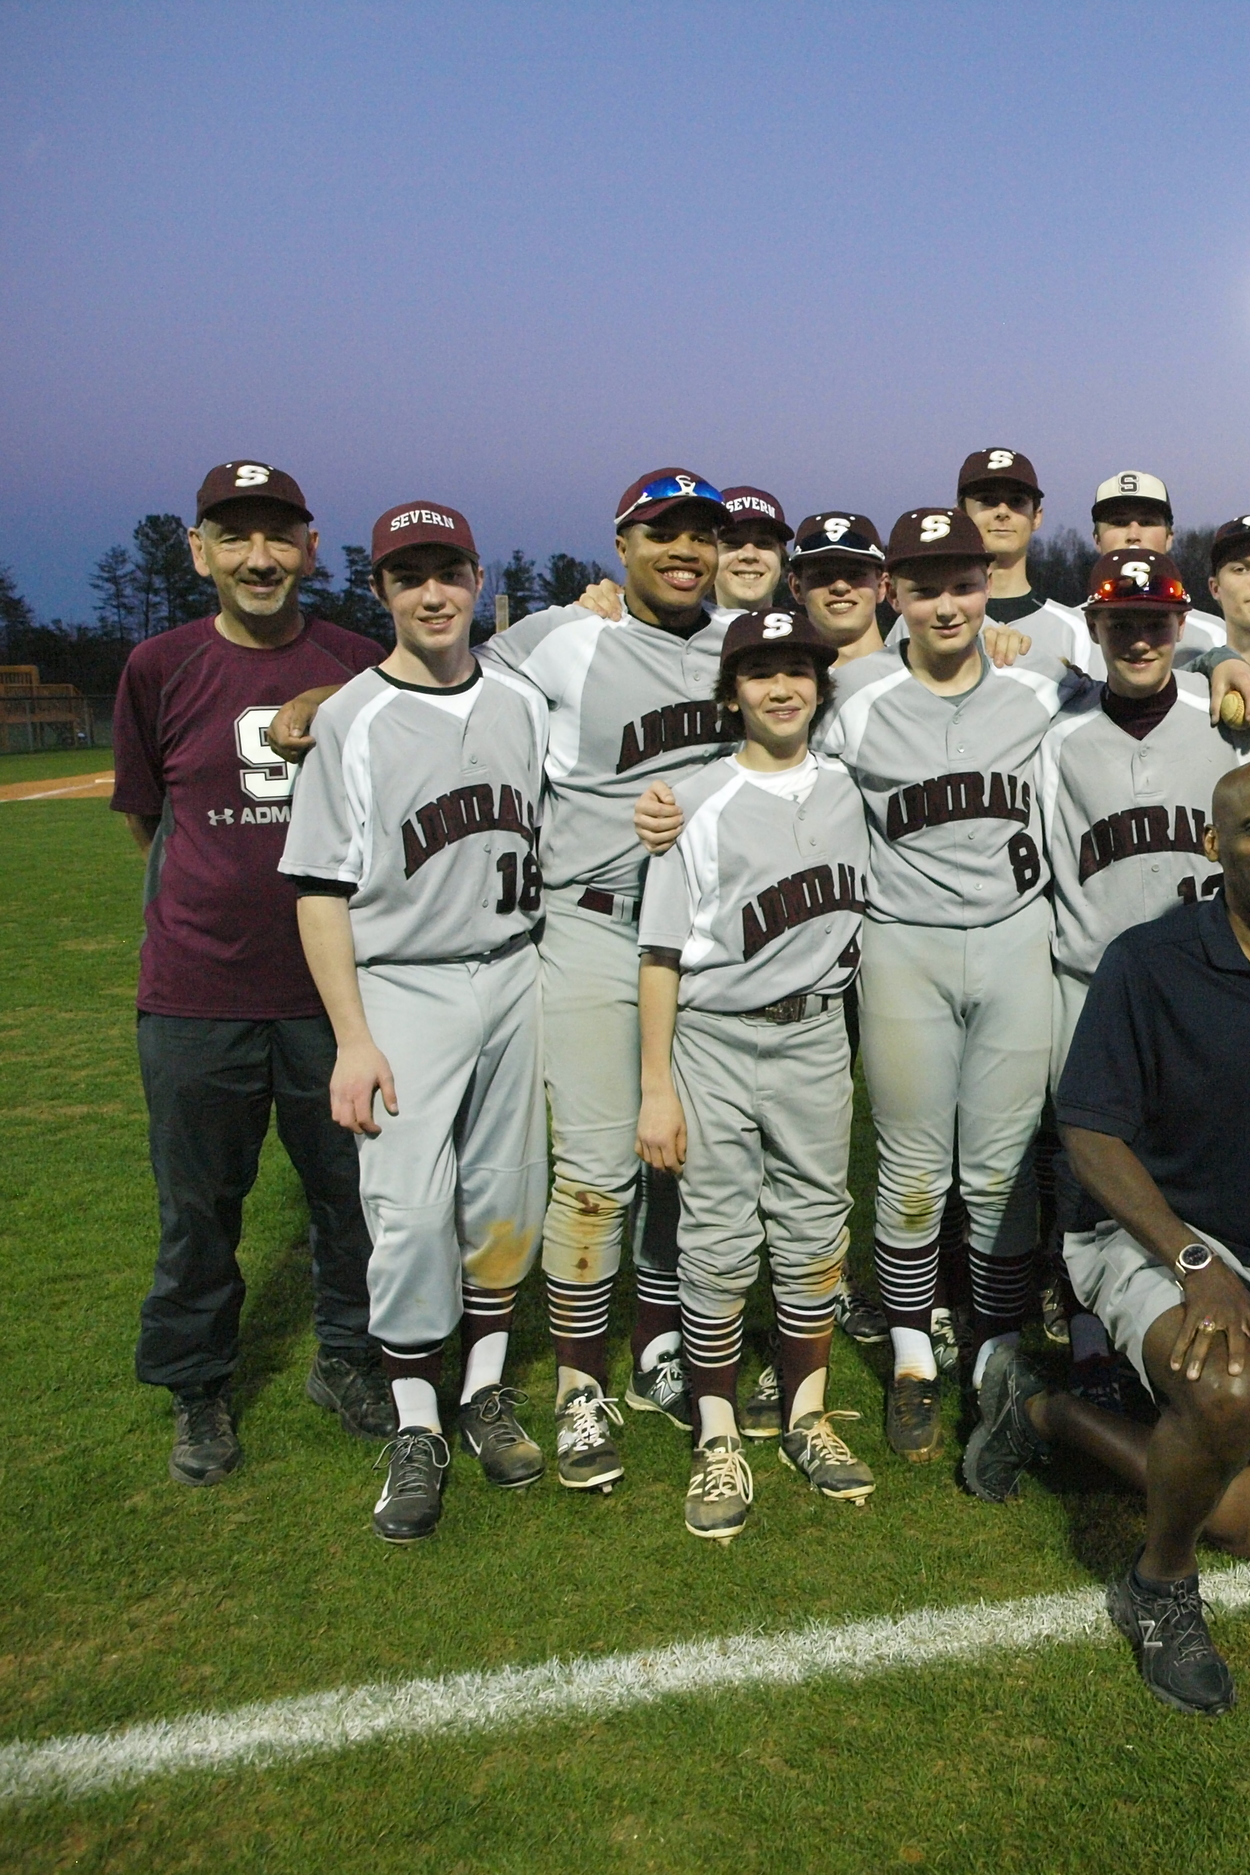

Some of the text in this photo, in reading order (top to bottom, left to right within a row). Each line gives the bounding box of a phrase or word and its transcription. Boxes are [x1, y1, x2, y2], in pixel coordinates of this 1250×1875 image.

[987, 450, 1014, 470] S
[234, 465, 270, 488] S
[1119, 473, 1140, 494] S
[725, 496, 776, 518] SEVERN
[390, 509, 455, 532] SEVERN
[823, 518, 851, 542] S
[919, 515, 952, 543] S
[762, 612, 794, 640] S
[233, 705, 302, 801] S
[1008, 832, 1041, 895] 8
[495, 851, 543, 914] 18
